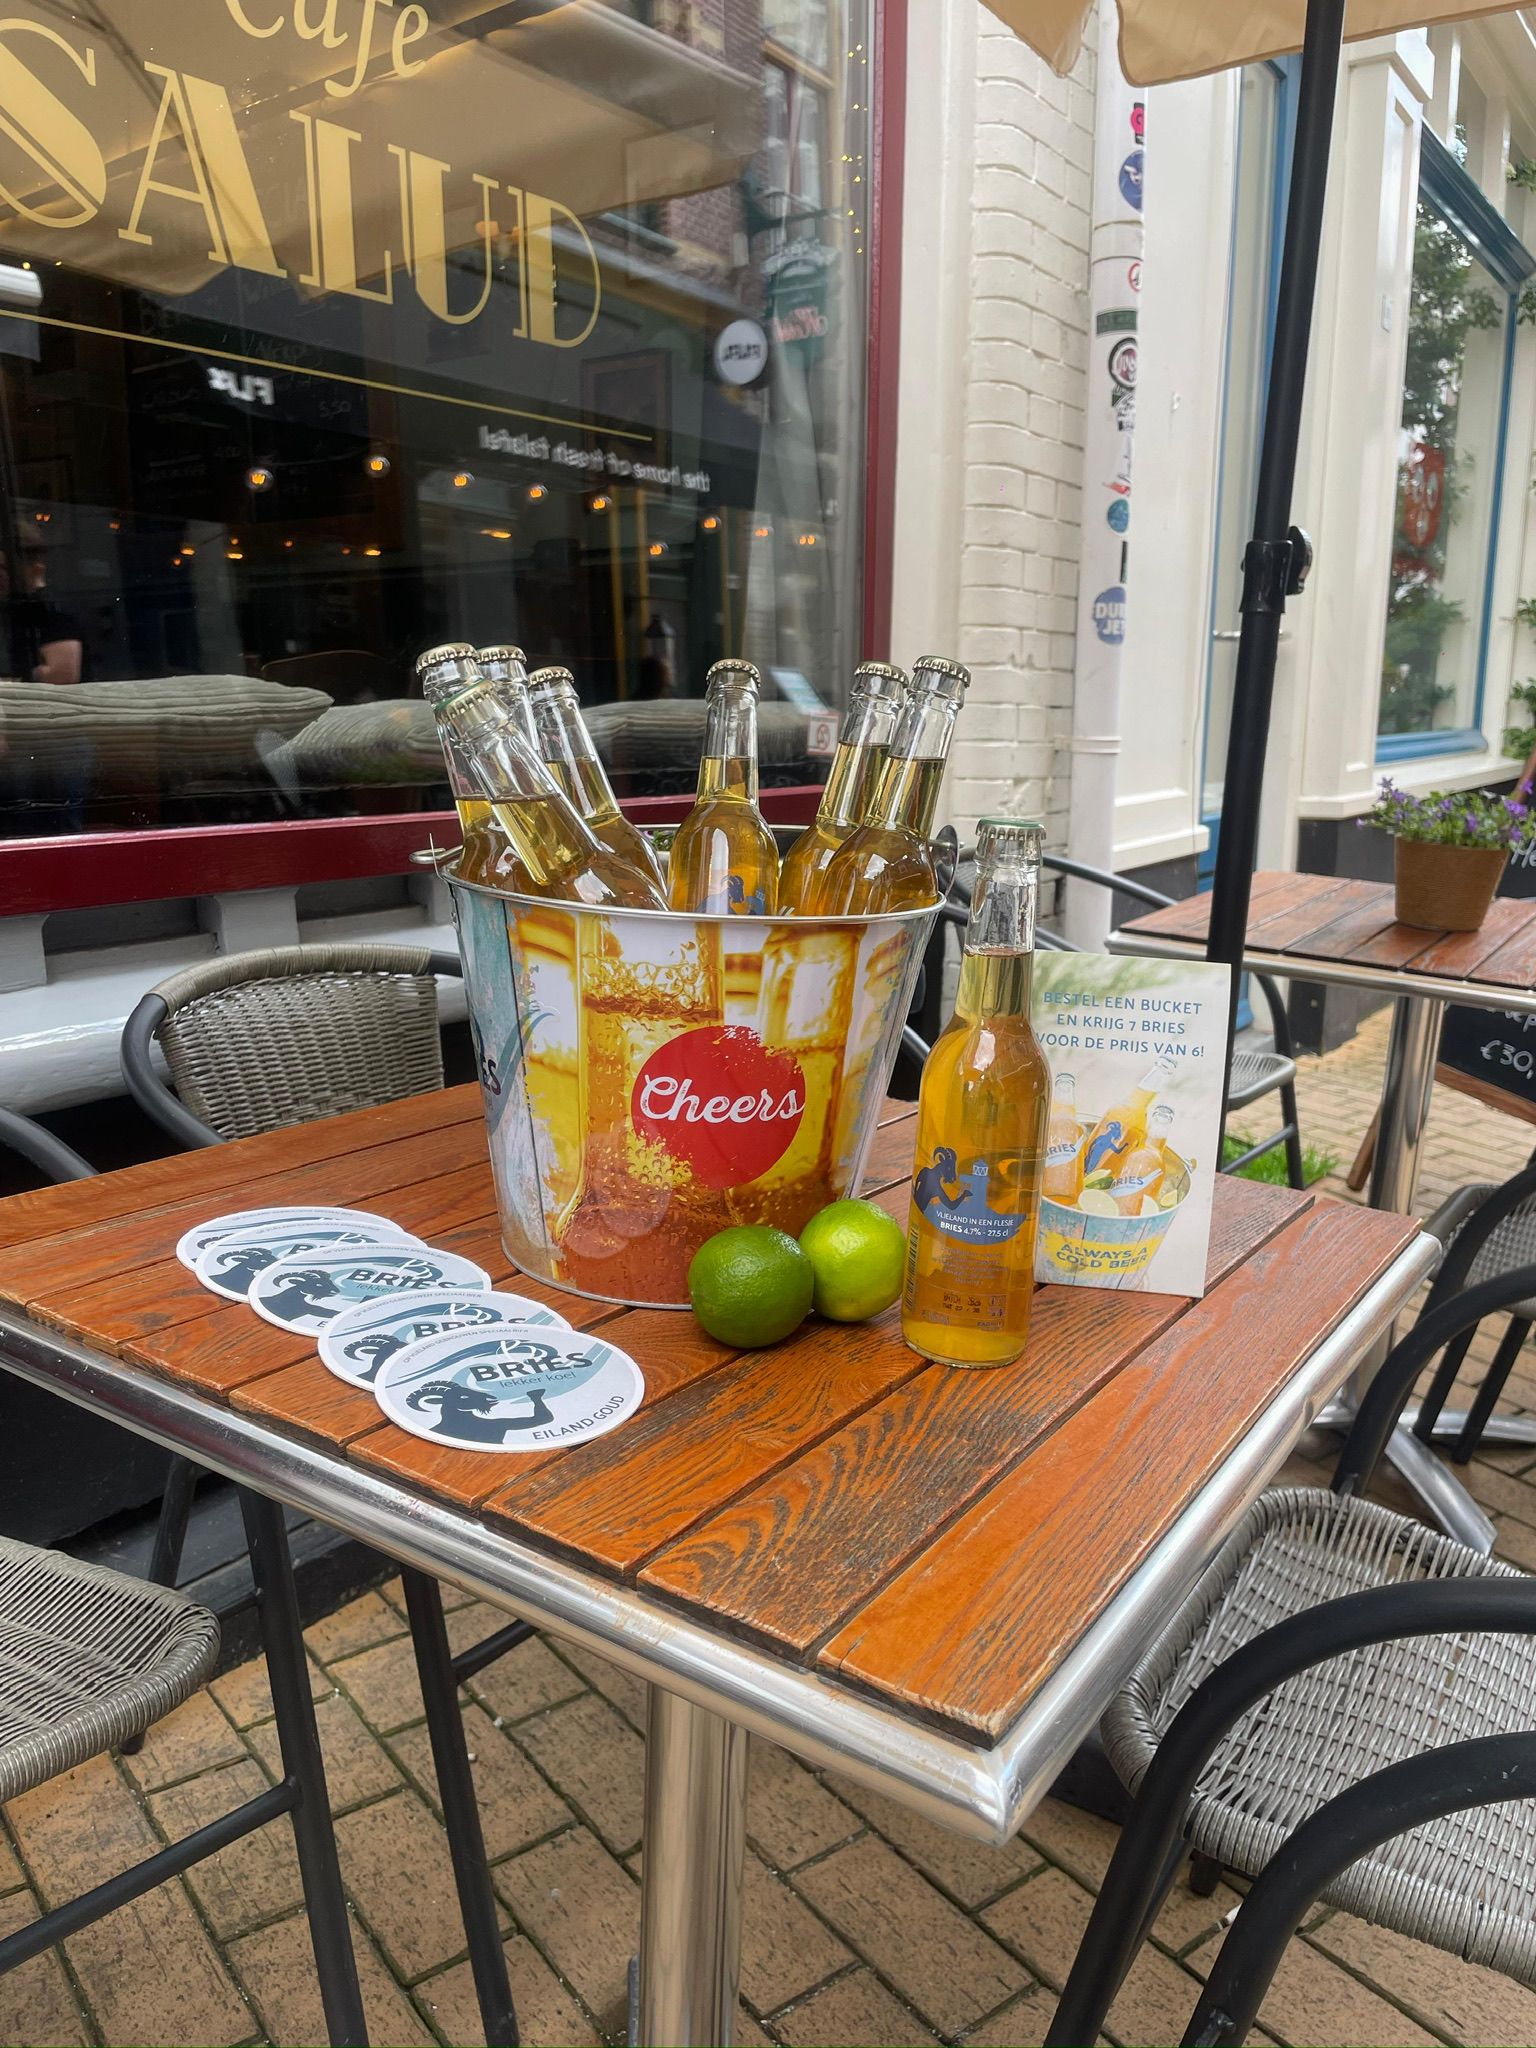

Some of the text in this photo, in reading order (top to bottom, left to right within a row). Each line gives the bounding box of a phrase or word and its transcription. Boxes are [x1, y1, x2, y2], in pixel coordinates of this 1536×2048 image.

[0, 18, 601, 348] SALUD
[1043, 992, 1202, 1015] BESTEL EEN BUCKET
[1056, 1014, 1186, 1035] EN KRIJG 7 BRIES
[1036, 1033, 1205, 1057] VOOR DE PRIJS VAN 6!
[640, 1075, 806, 1123] Cheers
[1047, 1143, 1076, 1157] RIES
[936, 1210, 1014, 1227] VLIELAND IN EEN FLESJE
[940, 1221, 963, 1233] BRIES
[1056, 1251, 1148, 1269] COLD BEER
[1061, 1244, 1148, 1259] ALWAYS A
[469, 1352, 593, 1382] BRIES
[499, 1371, 577, 1389] lekker koel
[532, 1395, 625, 1441] EILAND GOUD
